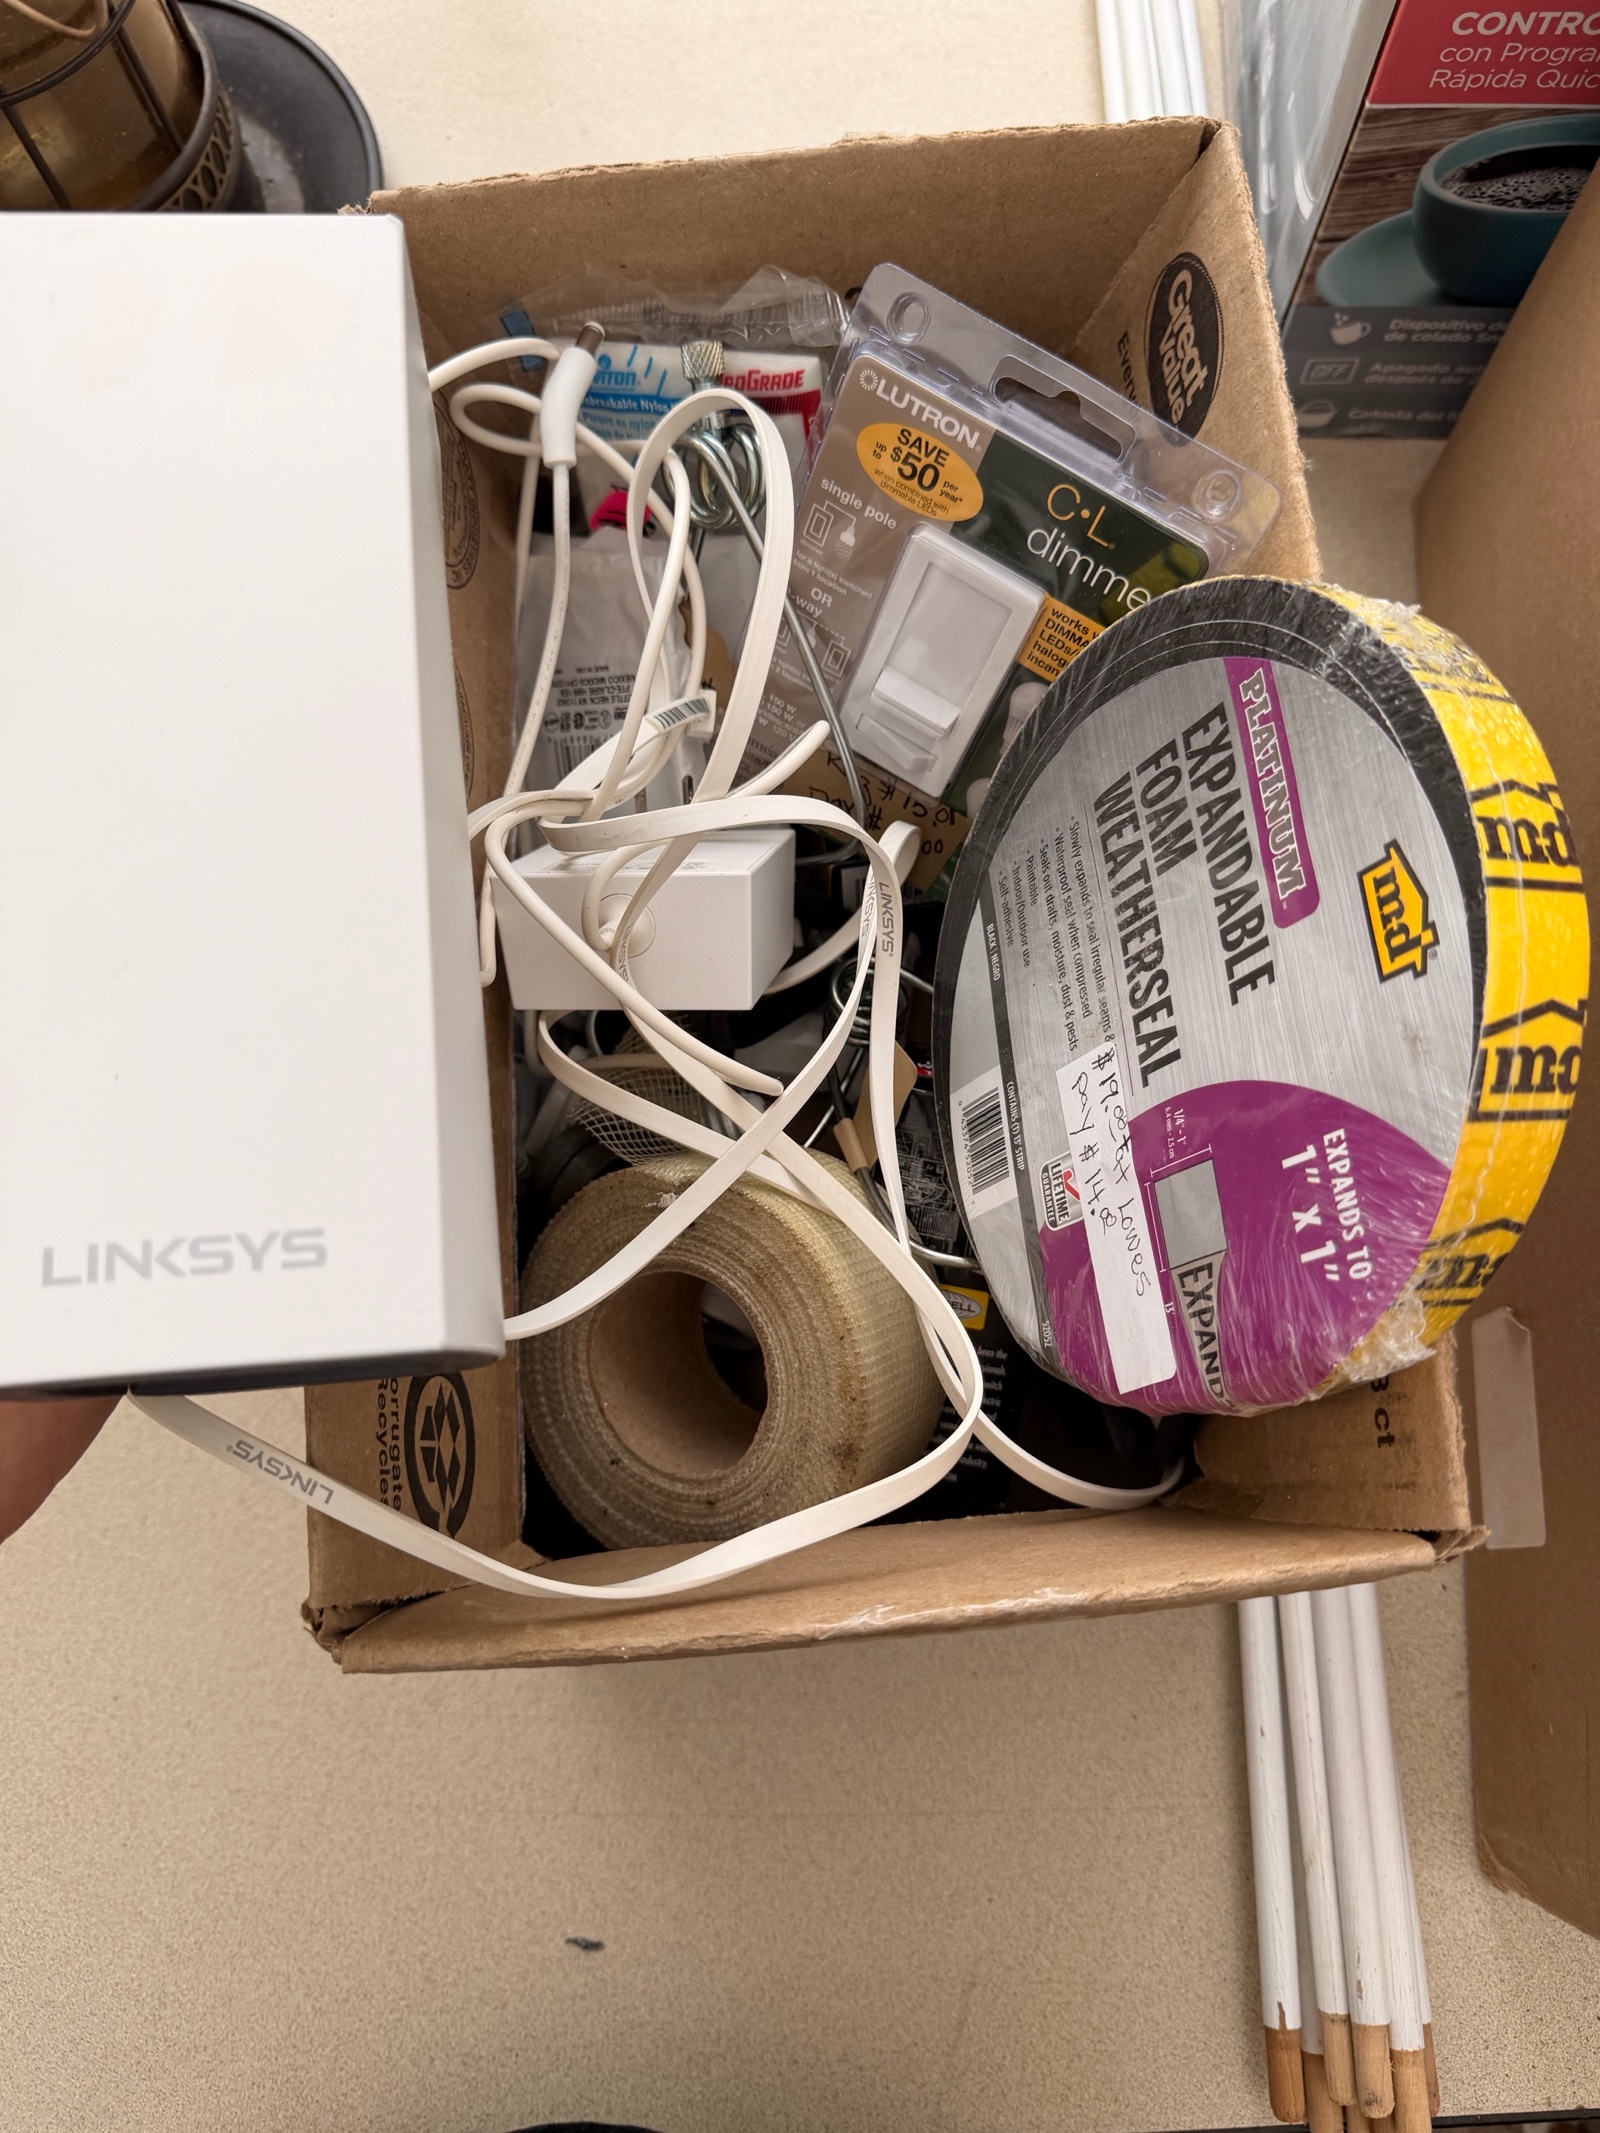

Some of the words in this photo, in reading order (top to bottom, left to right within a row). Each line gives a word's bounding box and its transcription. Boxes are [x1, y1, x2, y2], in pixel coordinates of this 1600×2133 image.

[1439, 47, 1492, 63] con
[1500, 42, 1600, 66] Progra
[1428, 68, 1528, 92] Rápida
[1536, 68, 1600, 89] Quic
[1167, 269, 1209, 408] Great
[1383, 331, 1406, 342] de
[1388, 318, 1486, 333] Dispositivo
[1159, 321, 1186, 425] Value
[640, 399, 669, 414] Nylon
[875, 378, 980, 450] LUTRON
[873, 449, 882, 460] to
[875, 441, 887, 453] up
[897, 428, 950, 468] SAVE
[890, 446, 940, 492] $50
[943, 479, 959, 493] per
[820, 478, 863, 510] single
[864, 506, 898, 530] pole
[874, 468, 895, 485] when
[896, 481, 933, 504] combined
[933, 499, 949, 515] with
[880, 481, 916, 505] dimmable
[917, 500, 937, 517] LEDs
[793, 559, 810, 574] from
[816, 573, 847, 596] location
[796, 550, 807, 561] for
[813, 560, 838, 582] light(s)
[838, 577, 873, 600] switched
[810, 587, 833, 608] OR
[1051, 608, 1090, 636] works
[1032, 640, 1069, 668] halog
[1039, 629, 1079, 657] LEDs/
[1239, 667, 1308, 900] PLATINUM
[1136, 738, 1198, 877] FOAM
[1039, 844, 1050, 875] Seals
[1069, 821, 1081, 862] Slowly
[1182, 702, 1276, 1006] EXPANDABLE
[1025, 855, 1038, 906] Paintable
[1054, 832, 1071, 892] Waterproof
[1042, 874, 1053, 893] out
[1074, 861, 1090, 908] expands
[878, 881, 895, 954] LINKSYS
[998, 873, 1014, 948] Self-adhesive
[1012, 865, 1028, 946] Indoor/Outdoor
[1020, 944, 1031, 968] use
[1046, 893, 1058, 931] drafts,
[1063, 891, 1076, 918] seal
[1083, 906, 1092, 919] to
[985, 923, 996, 950] BLACK
[1067, 918, 1080, 951] when
[1086, 919, 1098, 943] seal
[1093, 770, 1182, 1089] WEATHERSEAL
[989, 954, 1001, 982] NEGRO
[1051, 930, 1067, 984] moisture,
[1090, 942, 1106, 995] irregular
[1060, 983, 1071, 1010] dust
[1072, 950, 1093, 1018] compressed
[1065, 1019, 1078, 1052] pests
[1006, 1080, 1020, 1120] CONTAINS
[1010, 1120, 1020, 1134] (1)
[1013, 1134, 1022, 1145] 13'
[1176, 1135, 1187, 1145] 1"
[1015, 1144, 1025, 1172] STRIP
[1281, 1144, 1321, 1184] 1"
[1041, 1172, 1056, 1223] GUARANTEE
[1050, 1162, 1071, 1222] LIFETIME
[1323, 1128, 1365, 1243] EXPANDS
[1347, 1246, 1373, 1281] TO
[41, 1226, 329, 1288] LINKSYS
[1300, 1240, 1340, 1282] 1"
[1163, 1301, 1176, 1316] 13'
[1041, 1320, 1053, 1348] 52052
[1177, 1261, 1225, 1400] EXPAND
[1374, 1406, 1395, 1448] ct
[231, 1438, 335, 1506] LINKSYS
